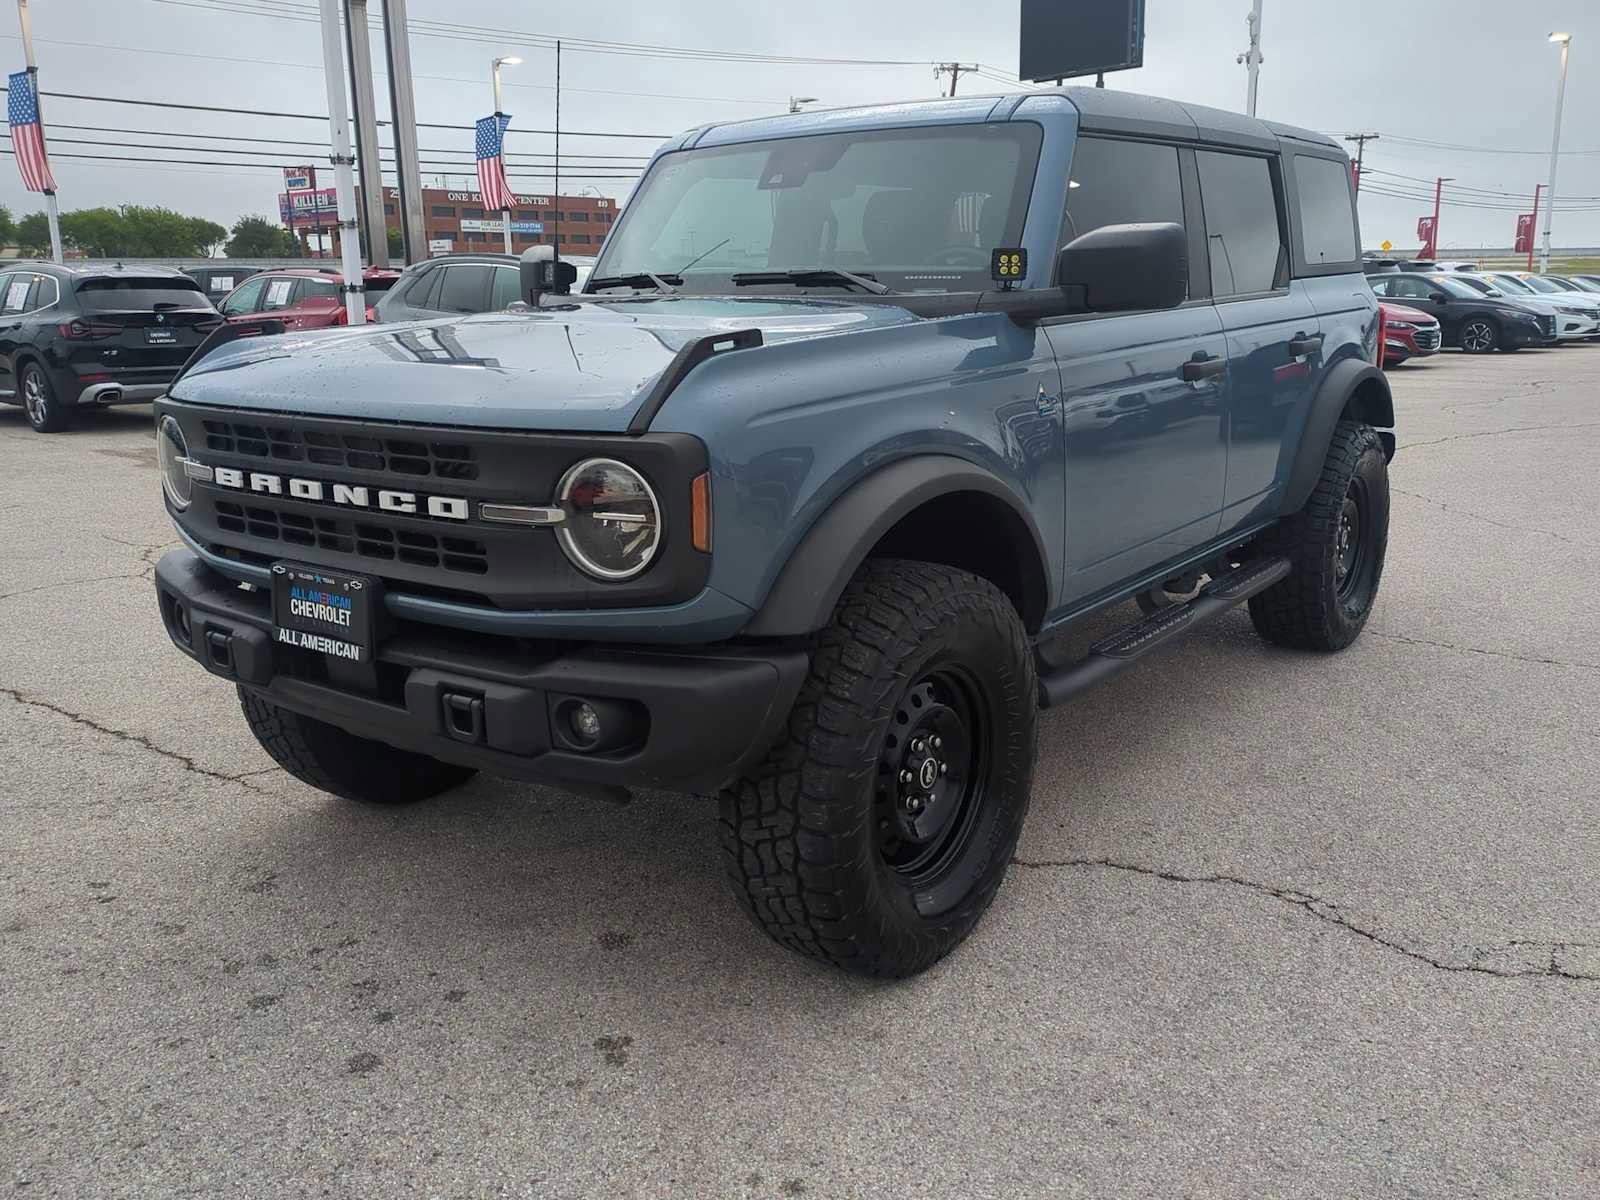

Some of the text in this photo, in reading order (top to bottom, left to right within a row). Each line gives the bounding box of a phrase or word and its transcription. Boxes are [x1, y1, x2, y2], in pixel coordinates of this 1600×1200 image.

[448, 192, 468, 201] ONE
[214, 467, 469, 520] BRONCO
[290, 585, 351, 609] ALL AMERICAN
[290, 598, 351, 627] CHEVROLET
[278, 628, 359, 661] ALL AMERICAN
